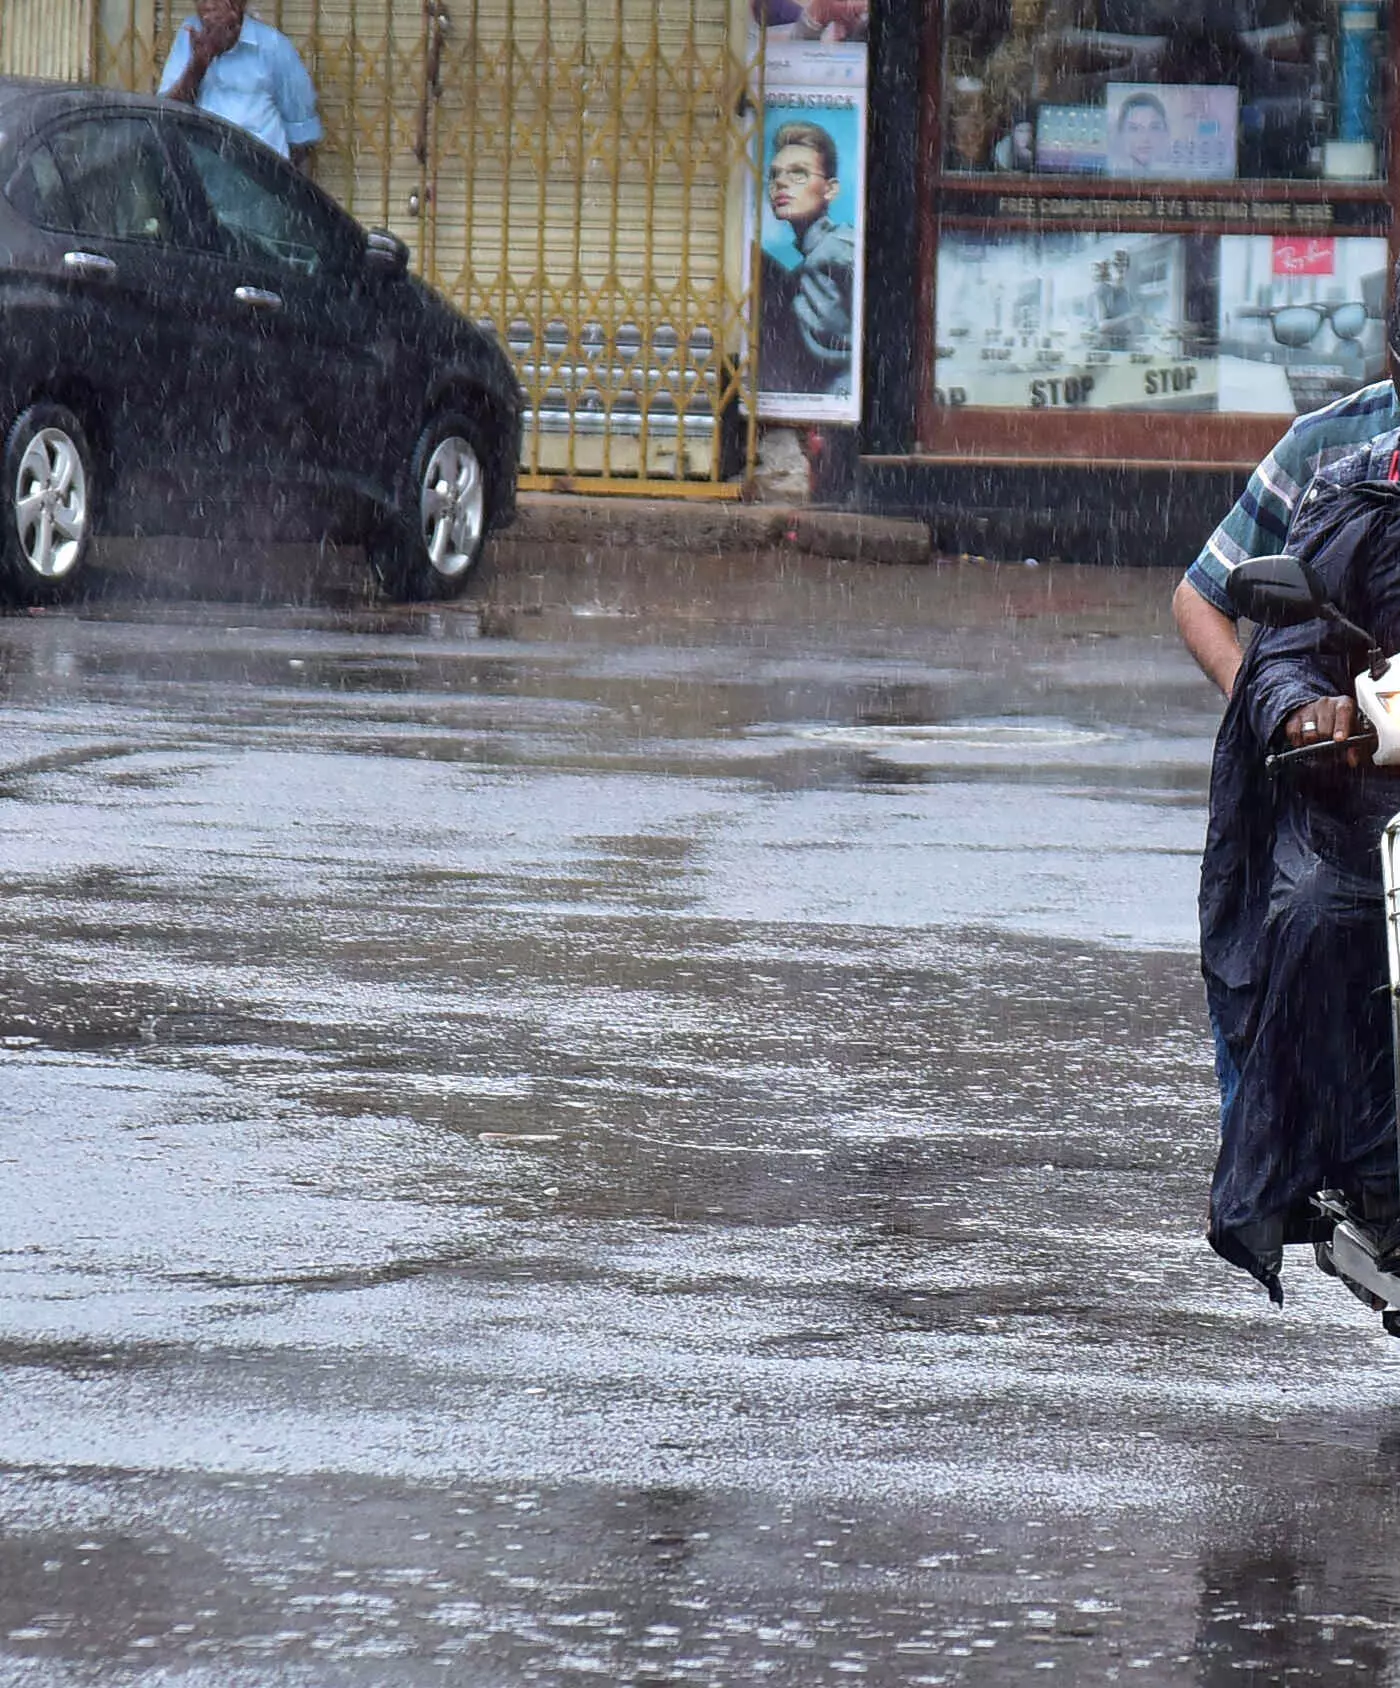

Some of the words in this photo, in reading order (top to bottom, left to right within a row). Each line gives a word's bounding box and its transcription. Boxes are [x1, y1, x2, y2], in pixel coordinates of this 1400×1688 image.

[999, 197, 1036, 213] FREE
[1039, 199, 1153, 215] COMPUTERISED
[1156, 200, 1184, 216] EYE
[1187, 201, 1249, 217] TESTING
[1252, 203, 1291, 218] DONE
[1295, 204, 1334, 219] HERE
[1029, 374, 1096, 409] STOP
[1144, 365, 1198, 395] STOP
